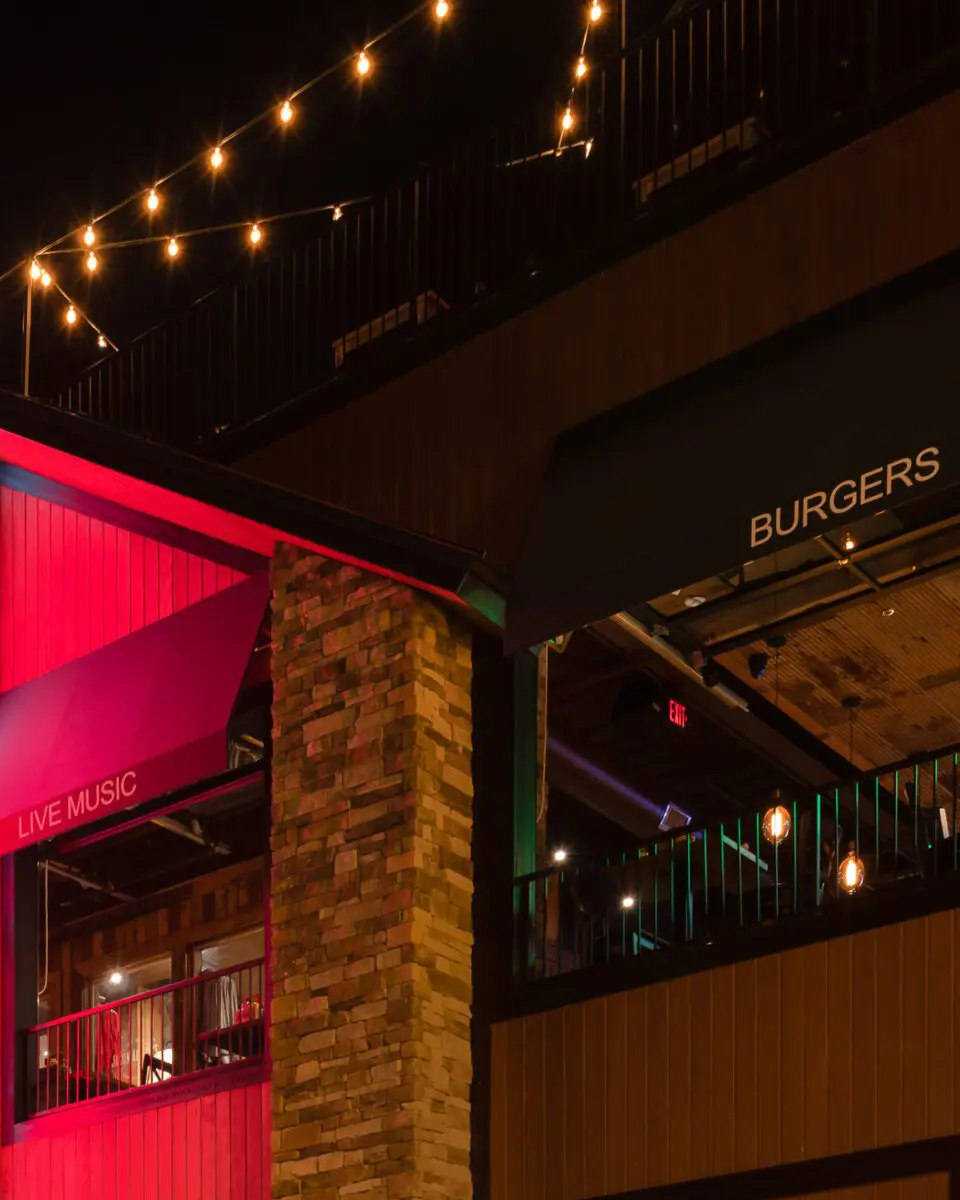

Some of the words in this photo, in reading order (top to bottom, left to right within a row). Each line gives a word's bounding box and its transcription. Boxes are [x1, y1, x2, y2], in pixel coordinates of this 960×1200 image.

[750, 446, 940, 549] BURGERS
[669, 699, 686, 728] EXIT
[18, 800, 62, 838] LIVE
[67, 770, 137, 820] MUSIC
